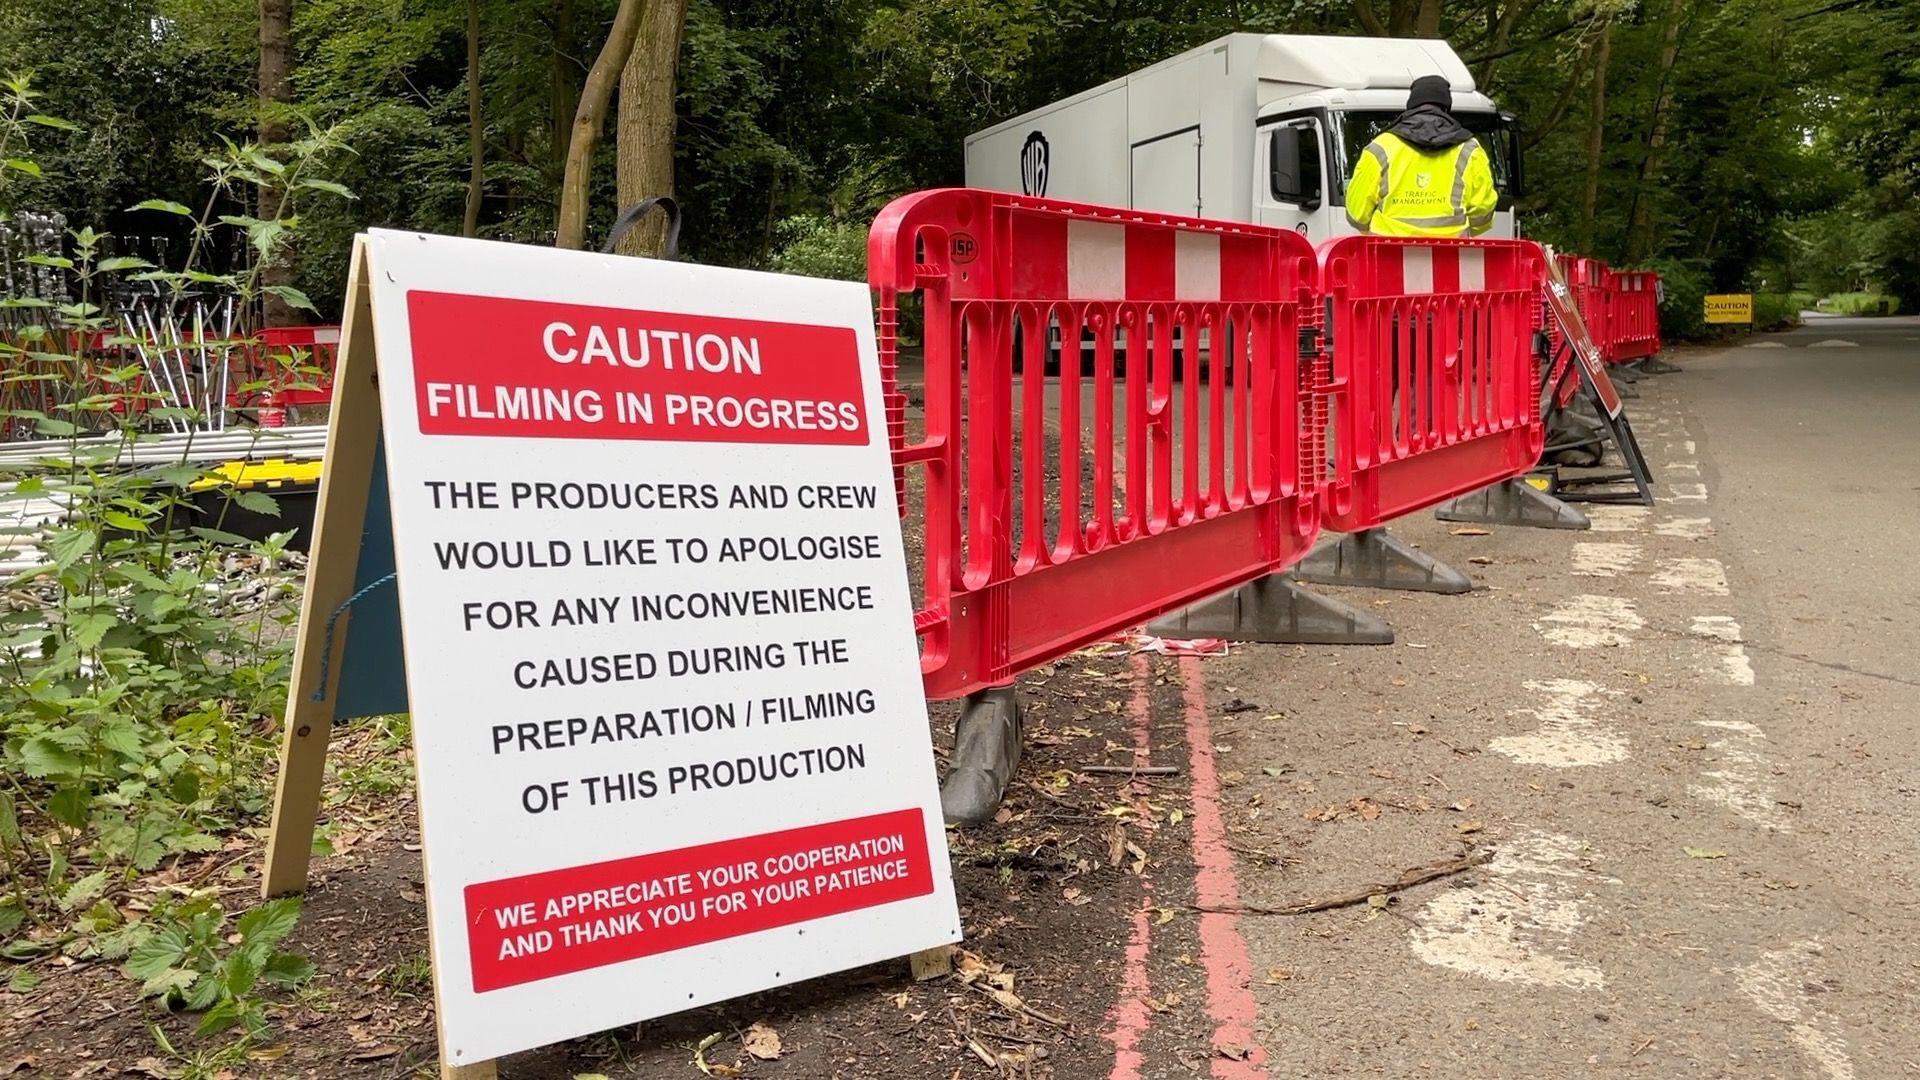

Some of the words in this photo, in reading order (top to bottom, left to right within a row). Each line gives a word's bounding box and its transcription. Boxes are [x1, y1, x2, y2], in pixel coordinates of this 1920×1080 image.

[1023, 139, 1047, 197] WB
[1392, 197, 1446, 205] MANAGEMENT
[1405, 190, 1437, 198] TRAFFIC
[1707, 302, 1749, 310] CAUTION
[542, 321, 762, 375] CAUTION
[426, 382, 604, 423] FILMING
[615, 391, 654, 424] IN
[665, 394, 859, 431] PROGRESS
[424, 482, 499, 509] THE
[511, 483, 719, 509] PRODUCERS
[729, 485, 788, 509] AND
[797, 486, 876, 509] CREW
[434, 540, 571, 570] WOULD
[583, 539, 657, 566] LIKE
[665, 538, 708, 564] TO
[718, 535, 881, 562] APOLOGISE
[463, 599, 540, 631] FOR
[551, 596, 620, 626] ANY
[632, 586, 874, 622] INCONVENIENCE
[514, 653, 657, 689] CAUSED
[668, 643, 785, 677] DURING
[793, 638, 849, 666] THE
[492, 702, 736, 755] PREPARATION
[746, 700, 752, 727] /
[761, 689, 875, 725] FILMING
[522, 781, 569, 814] OF
[580, 770, 658, 806] THIS
[668, 743, 865, 794] PRODUCTION
[494, 902, 537, 929] WE
[544, 873, 693, 921] APPRECIATE
[696, 861, 760, 890] YOUR
[763, 834, 904, 877] COOPERATION
[499, 930, 553, 961] AND
[558, 911, 644, 947] THANK
[647, 900, 696, 928] YOU
[702, 891, 748, 918] FOR
[751, 875, 811, 907] YOUR
[814, 858, 909, 894] PATIENCE
